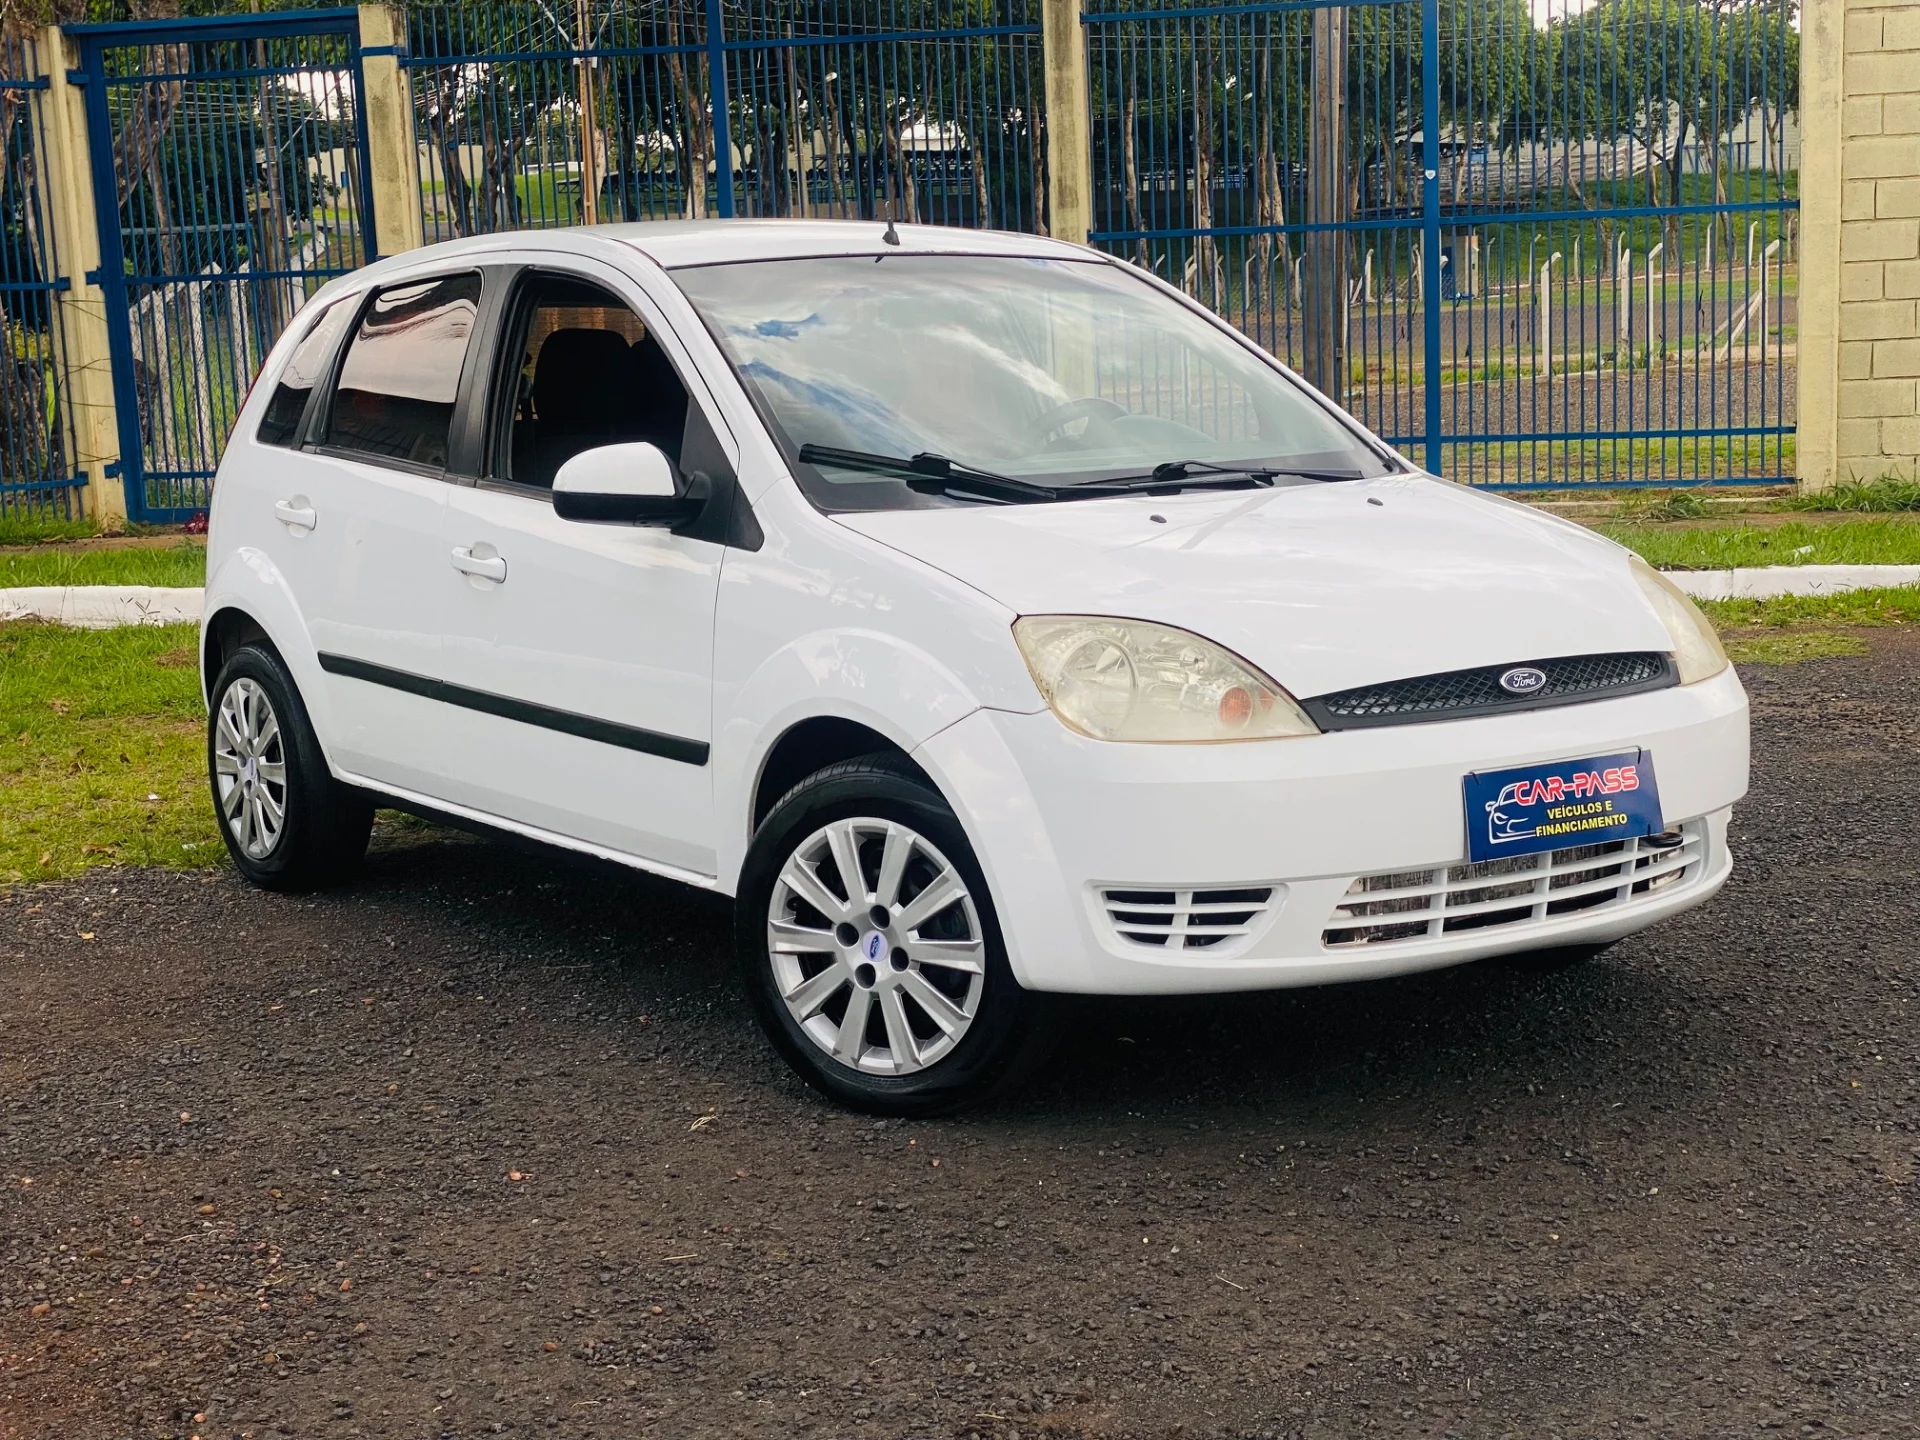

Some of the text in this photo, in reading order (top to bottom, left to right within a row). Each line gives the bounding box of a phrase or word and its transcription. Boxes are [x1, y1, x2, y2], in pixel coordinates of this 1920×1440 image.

[1513, 673, 1536, 687] Ford
[1514, 766, 1640, 806] CAR-PASS
[1547, 800, 1613, 820] VEÍCULOS E
[1535, 814, 1628, 837] FINANCIAMENTO
